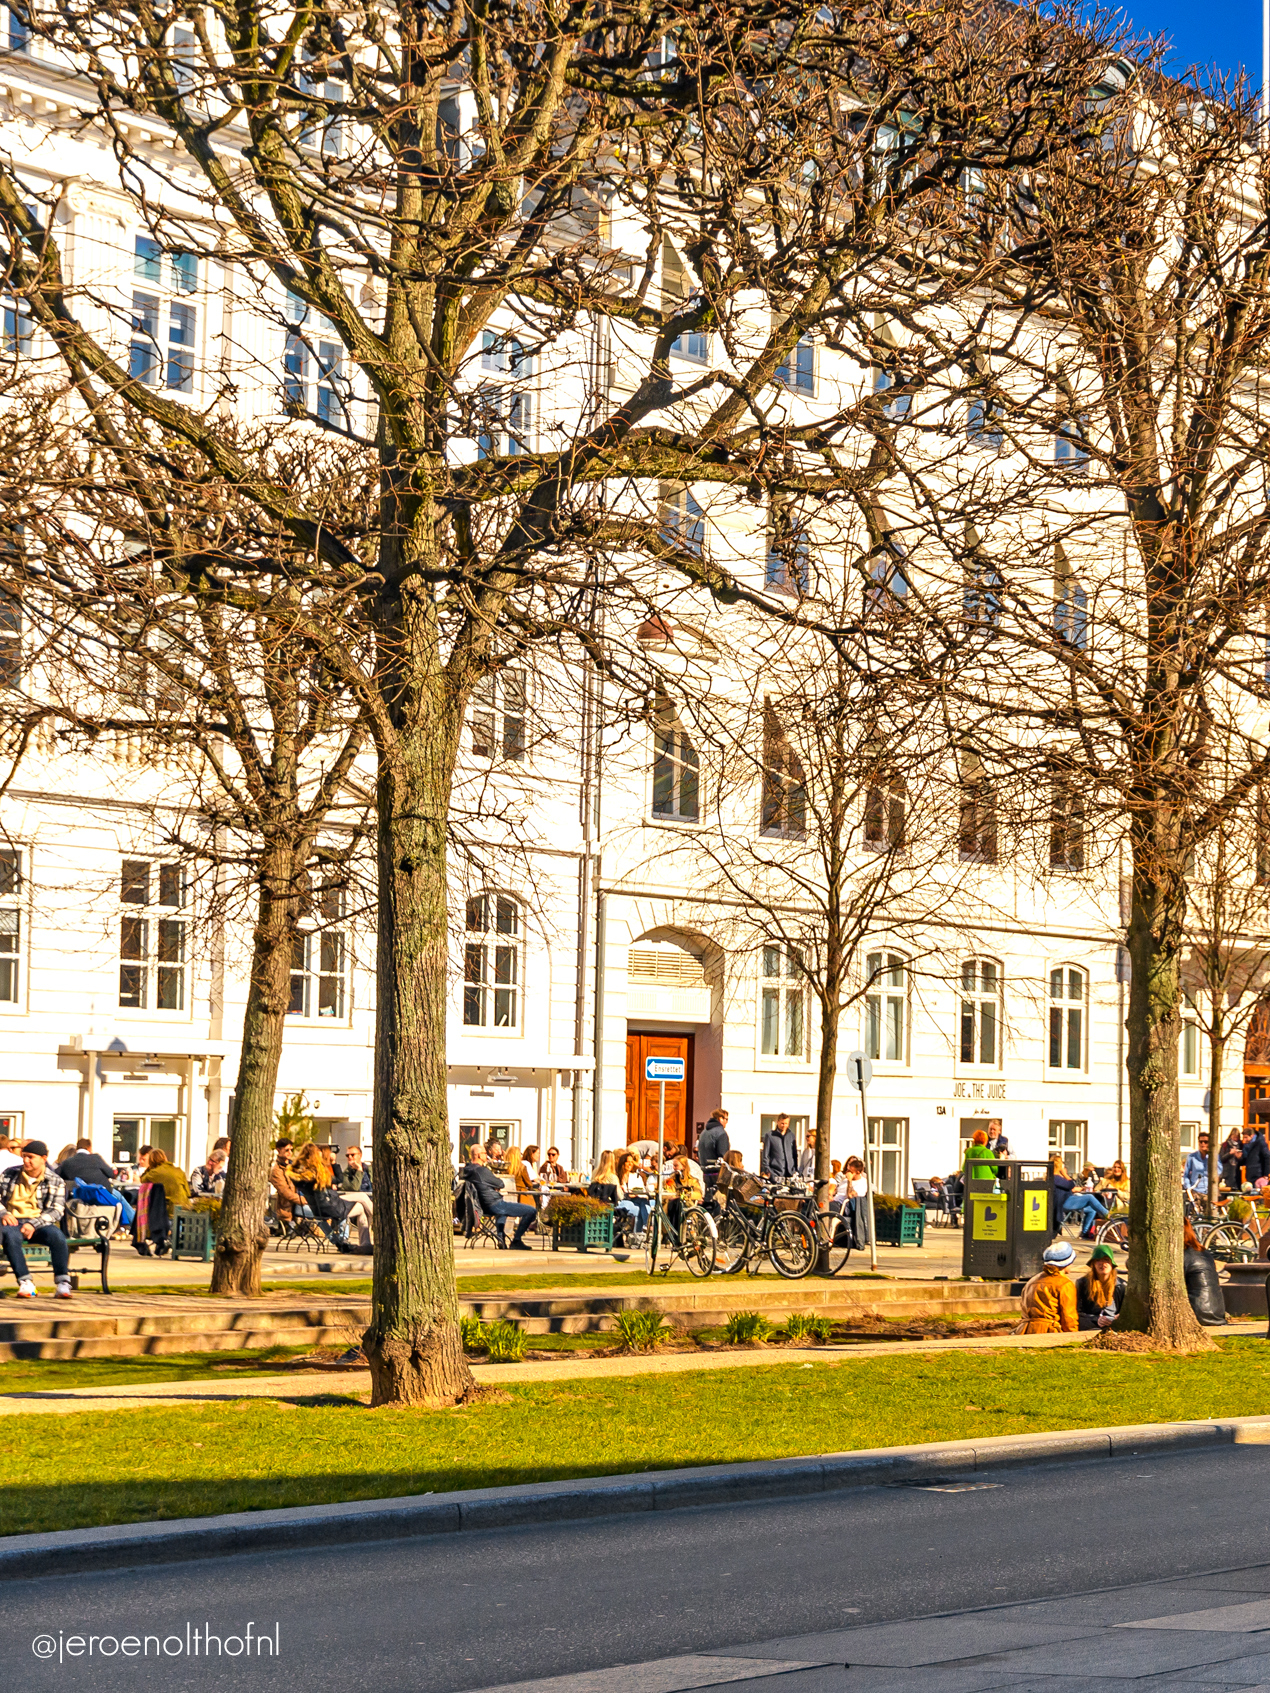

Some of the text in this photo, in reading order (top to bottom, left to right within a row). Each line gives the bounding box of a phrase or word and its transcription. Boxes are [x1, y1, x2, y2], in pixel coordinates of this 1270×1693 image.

[654, 1064, 681, 1073] Ensrettet
[953, 1082, 966, 1098] JOE
[972, 1083, 985, 1098] THE
[987, 1084, 1006, 1099] JUICE
